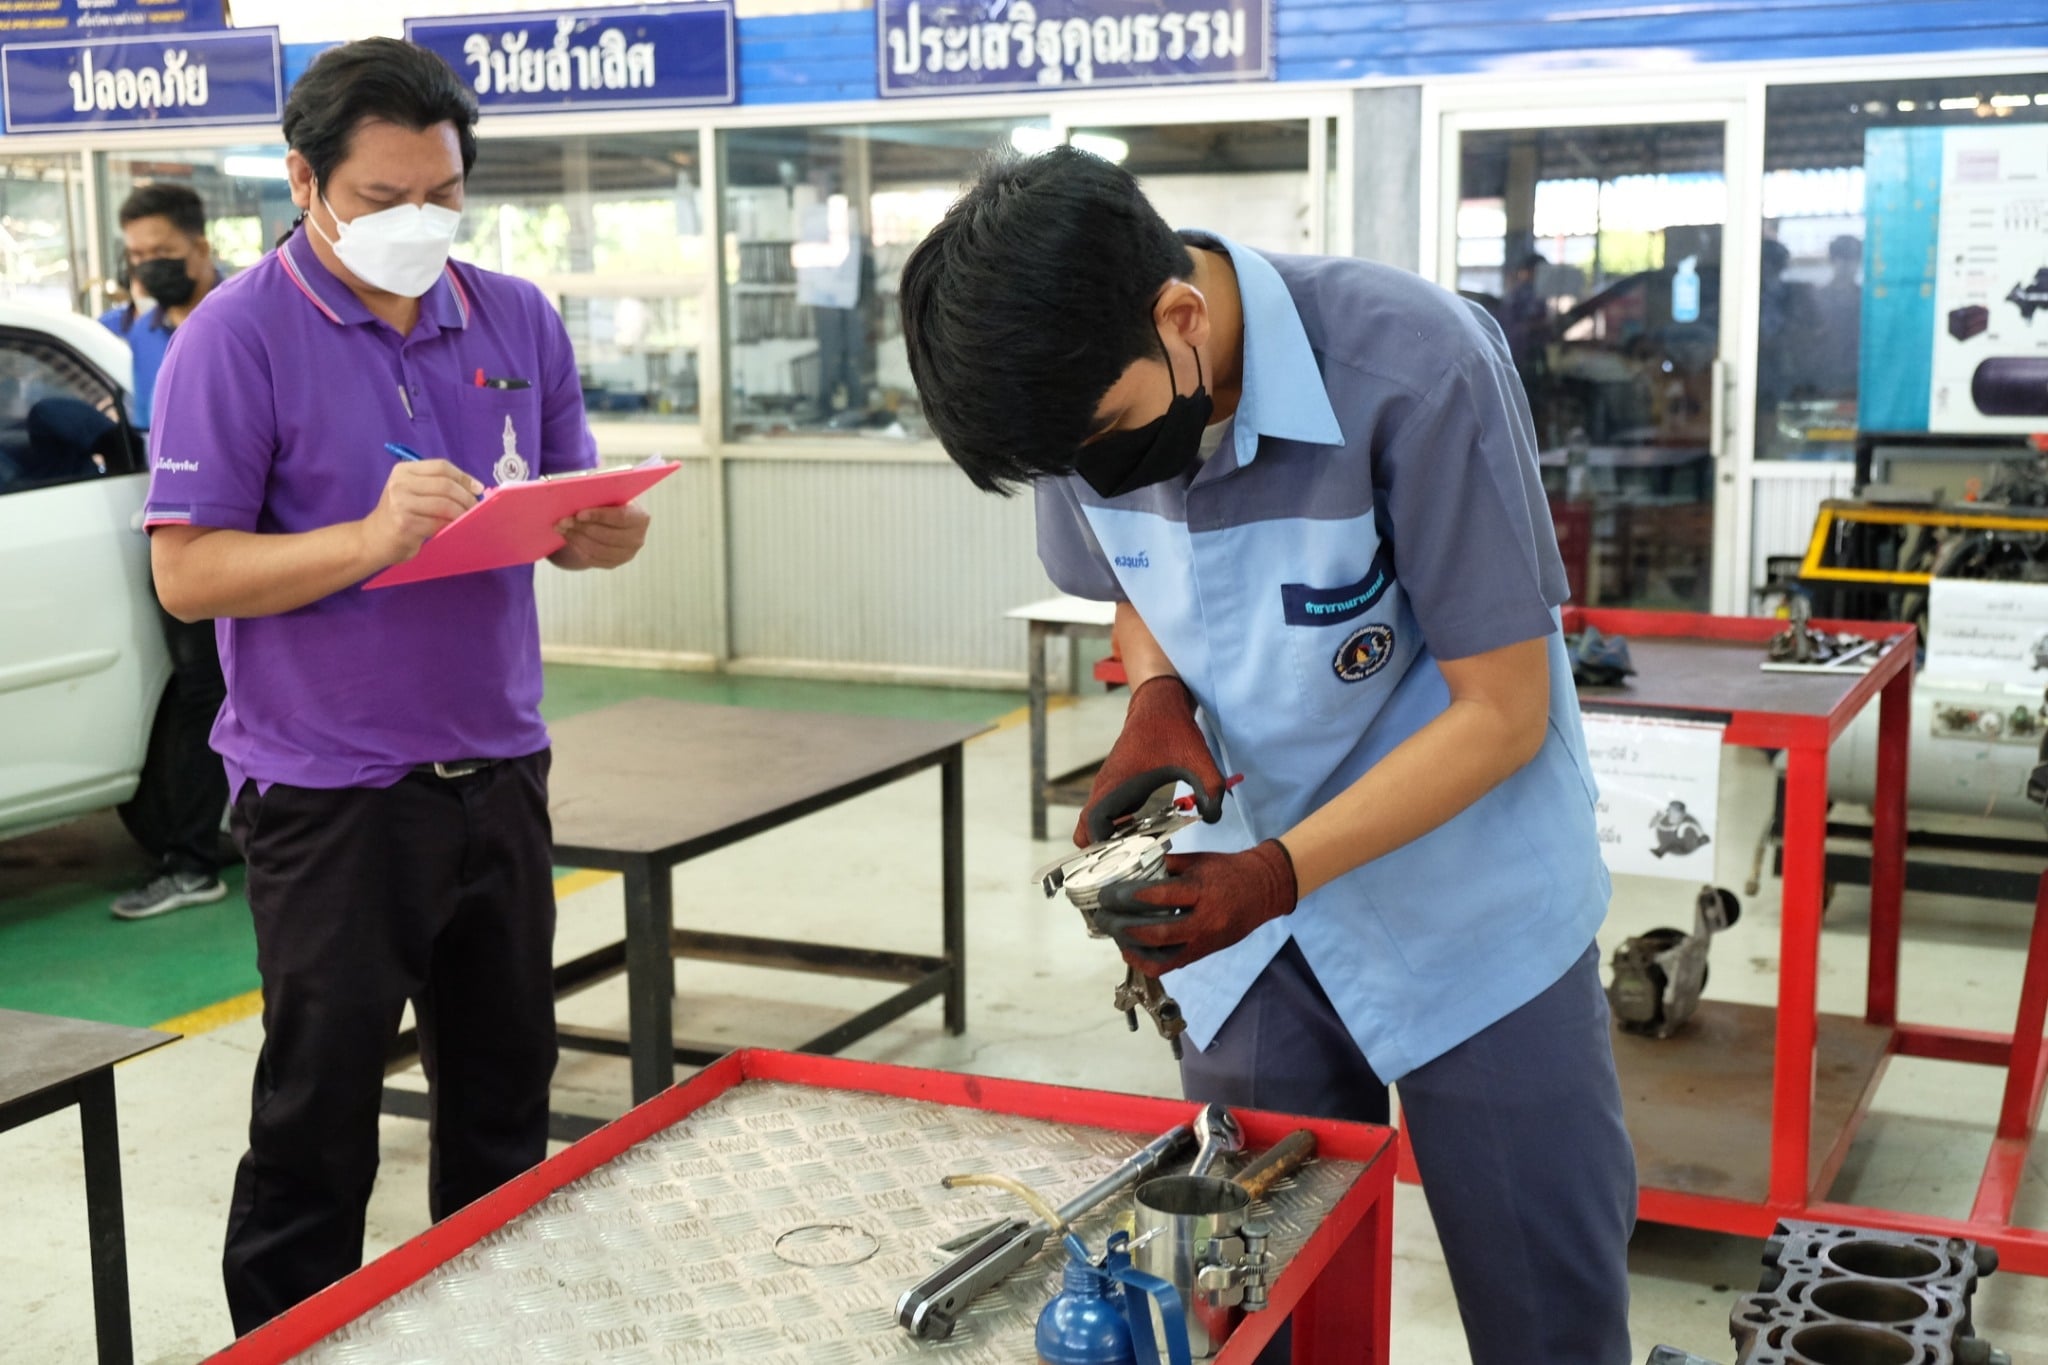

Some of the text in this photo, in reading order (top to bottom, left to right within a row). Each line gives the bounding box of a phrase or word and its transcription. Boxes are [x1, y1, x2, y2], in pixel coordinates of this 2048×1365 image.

[68, 48, 208, 112] ปลอดภัย
[463, 15, 655, 94] วินัยล้ำเลิศ
[888, 1, 1246, 85] ประเสริฐคุณธรรม
